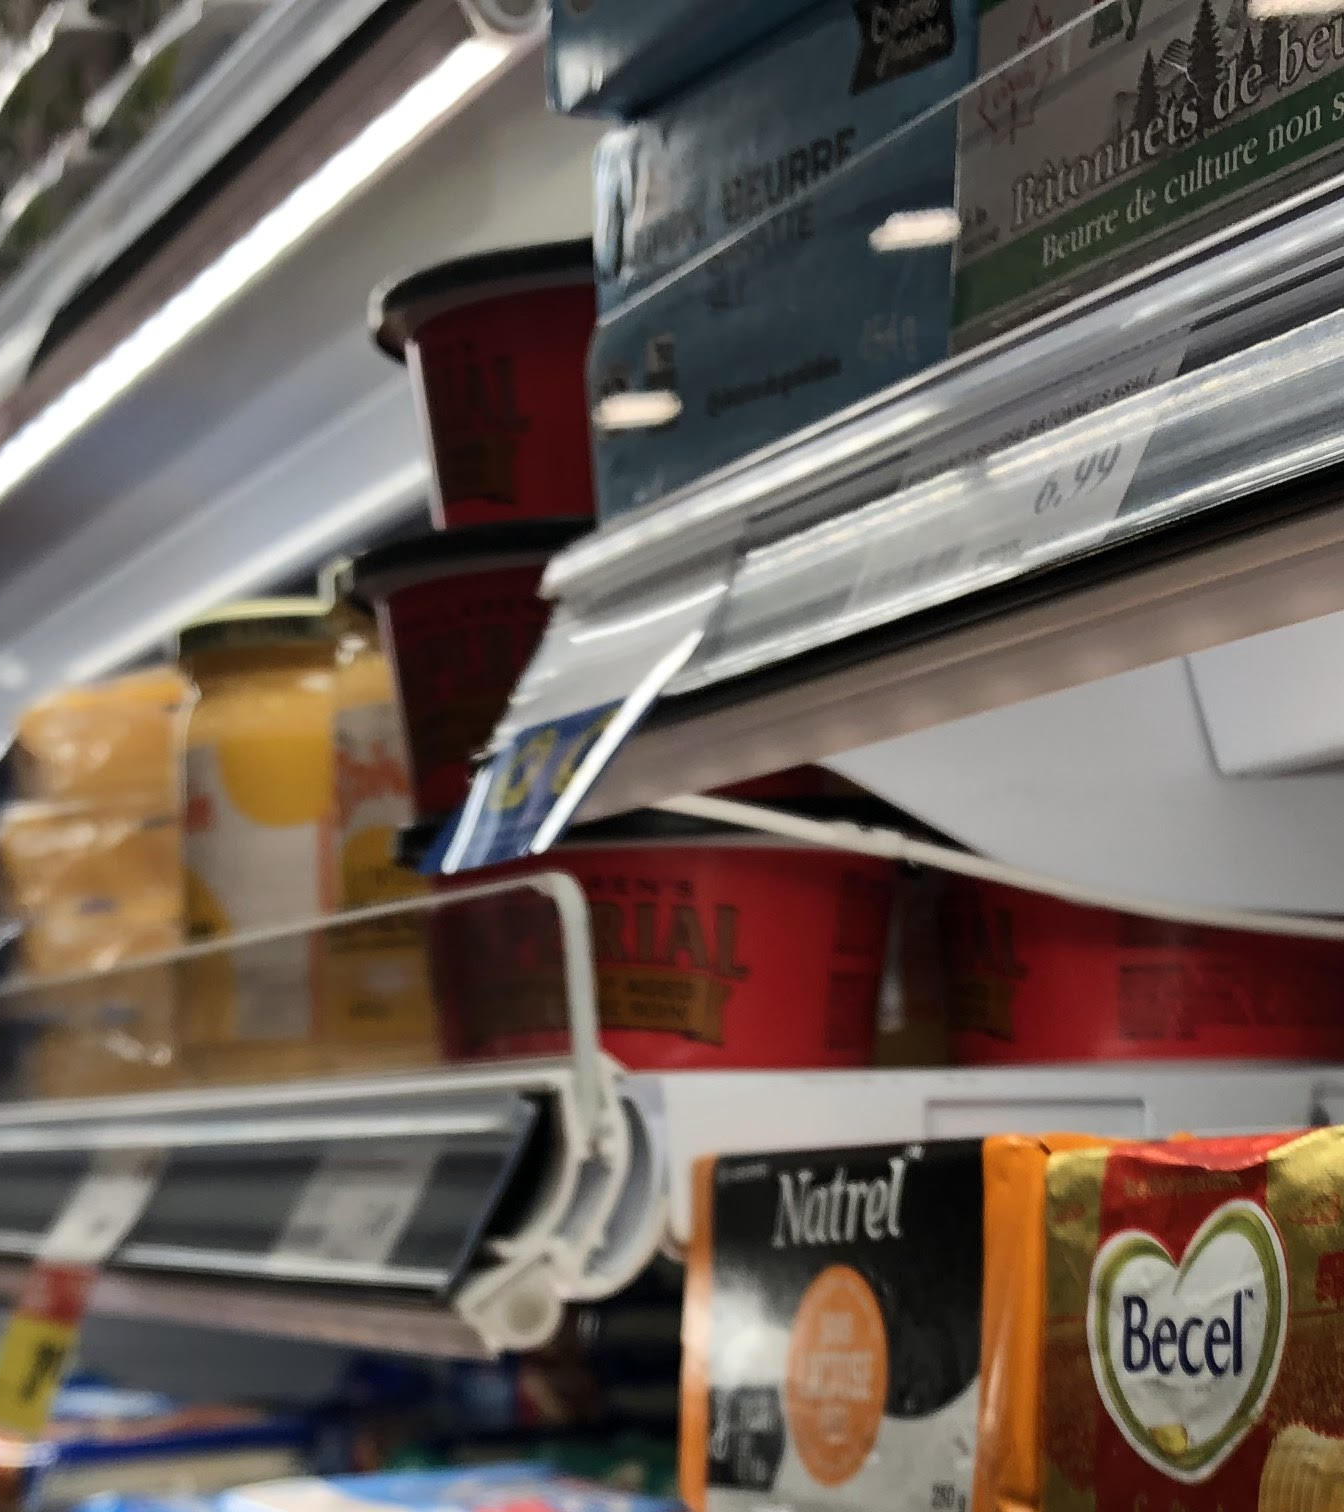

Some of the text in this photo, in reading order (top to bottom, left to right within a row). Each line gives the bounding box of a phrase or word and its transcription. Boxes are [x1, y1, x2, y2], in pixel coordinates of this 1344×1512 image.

[1212, 58, 1263, 121] de
[1042, 205, 1120, 268] Beurre
[1126, 188, 1156, 224] de
[1163, 135, 1258, 206] culture
[1266, 104, 1322, 156] non
[771, 1156, 907, 1250] Natrel
[1121, 1289, 1244, 1379] Becel
